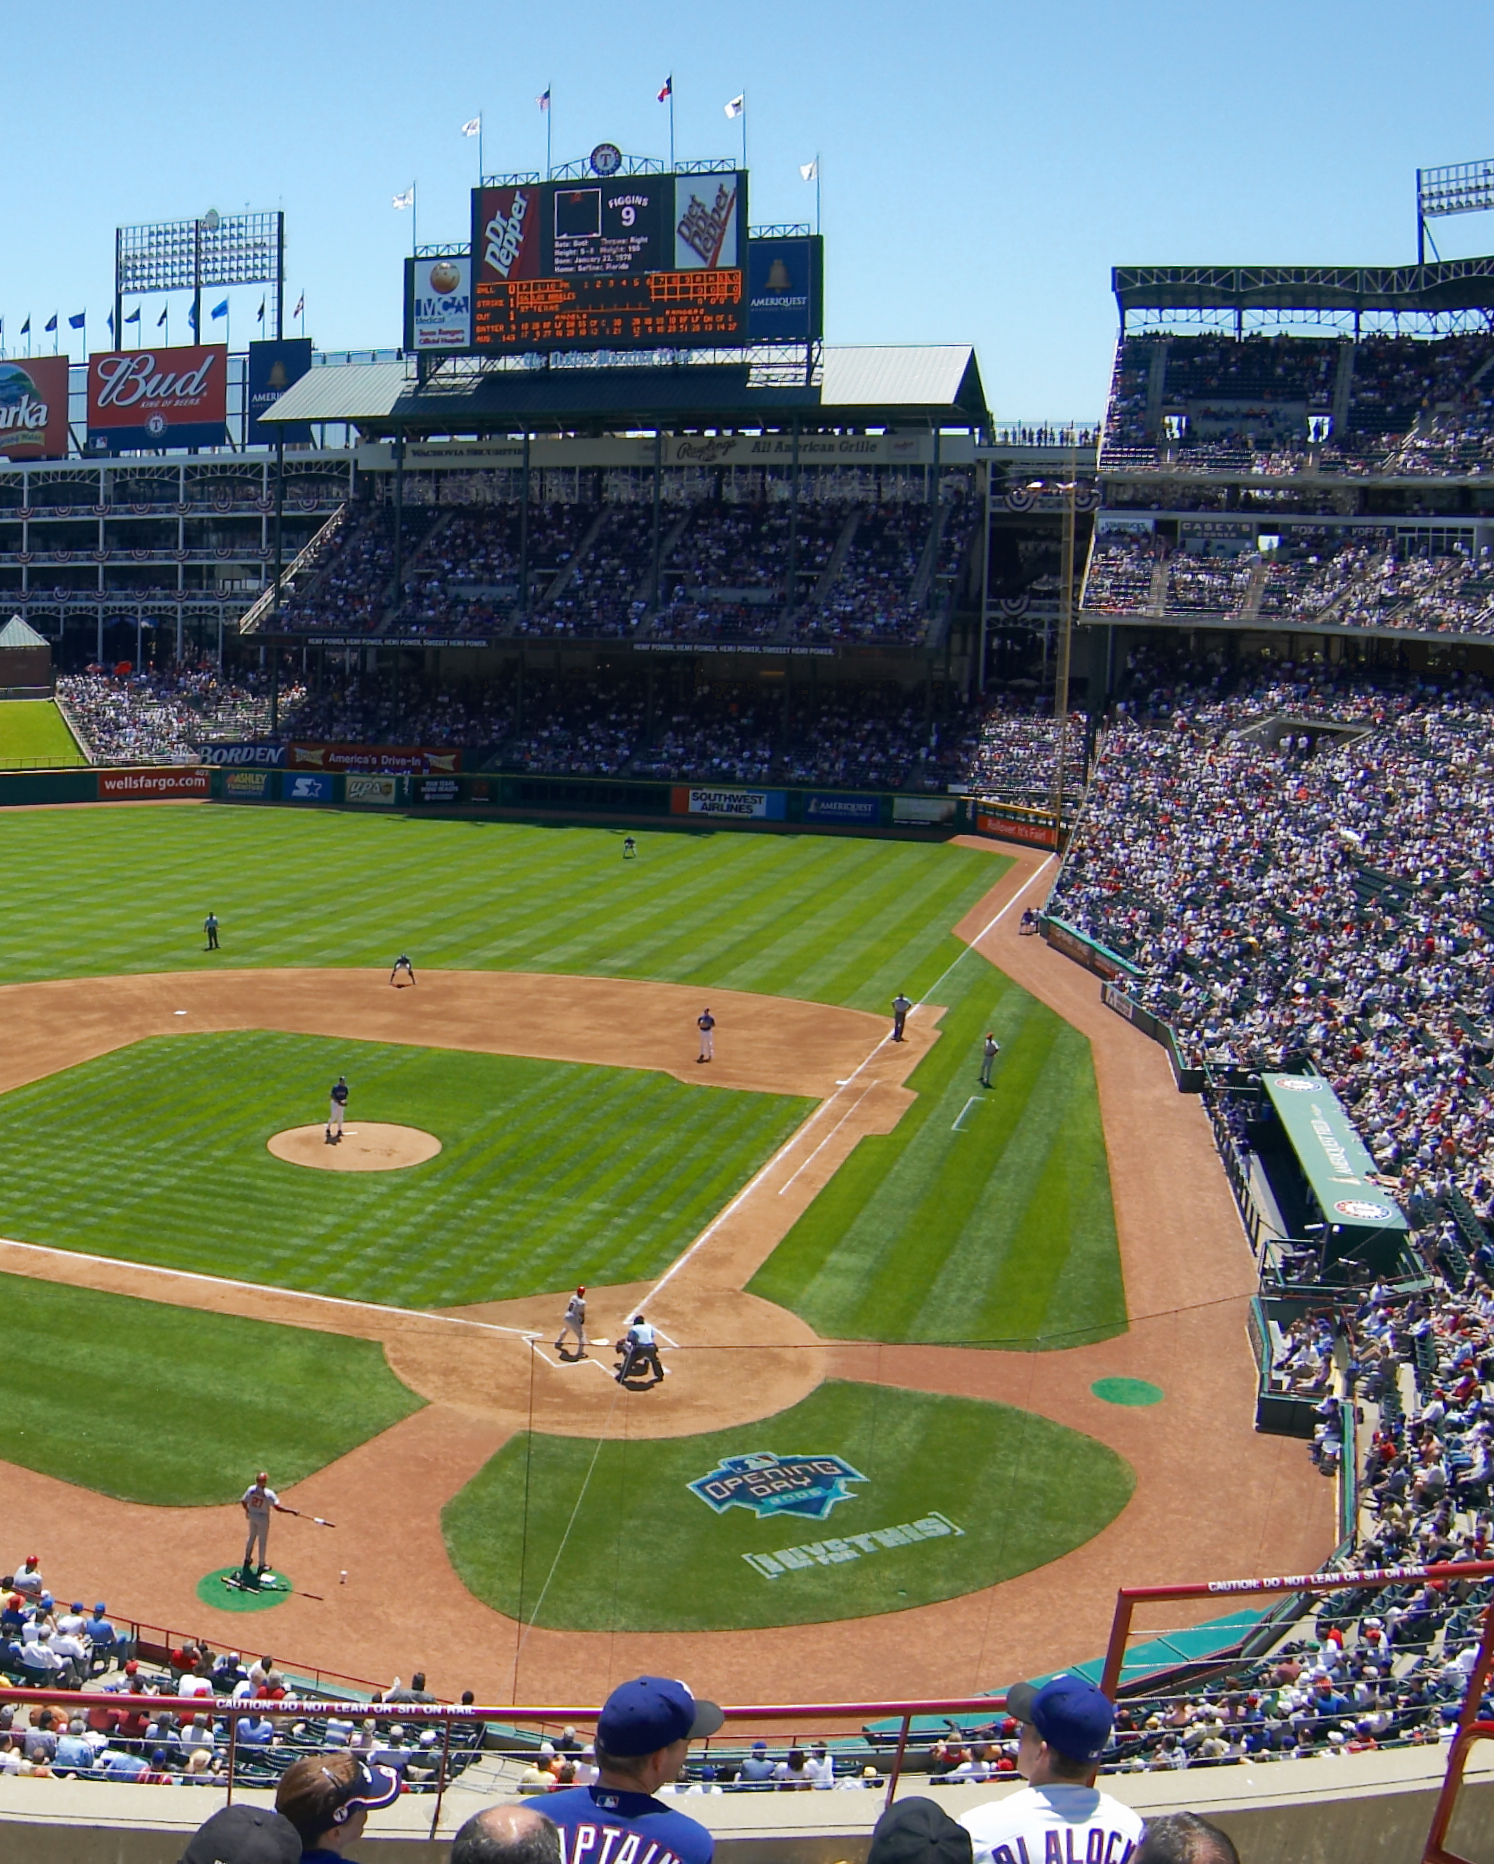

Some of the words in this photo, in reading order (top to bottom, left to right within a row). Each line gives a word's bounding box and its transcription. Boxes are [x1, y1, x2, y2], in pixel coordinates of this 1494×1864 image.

[608, 195, 649, 209] FIGGINS
[621, 206, 636, 227] 9
[485, 210, 508, 246] Dr
[689, 183, 729, 265] Pepper
[484, 190, 528, 278] Pepper
[574, 255, 601, 265] January
[476, 300, 505, 308] STRIKE
[750, 296, 808, 307] AMERIQUEST
[416, 316, 445, 325] Medical
[476, 313, 491, 321] OUT
[438, 328, 465, 338] Rangers
[476, 324, 504, 333] BATTER
[441, 336, 465, 345] Hospital
[97, 354, 215, 407] Bud
[750, 441, 772, 453] All
[1182, 522, 1251, 532] CASEY'S
[1291, 525, 1312, 536] FOX
[1318, 526, 1327, 536] 4
[1375, 527, 1387, 537] 27
[200, 745, 285, 765] BORDEN
[329, 753, 377, 766] America's
[380, 754, 422, 766] Drive-In
[105, 769, 206, 791] wellsfargo.com
[234, 774, 267, 784] ASHLEY
[349, 781, 381, 798] ups
[692, 792, 764, 804] SOUTHWEST
[700, 802, 754, 814] AIRLINES
[819, 802, 873, 812] AMERIQUEST
[1018, 824, 1030, 837] It's
[705, 1461, 844, 1501] OPENING
[749, 1477, 813, 1497] DAY
[769, 1487, 823, 1505] 2005
[1208, 1579, 1259, 1592] CAUTION:
[1262, 1577, 1281, 1589] DO
[1283, 1575, 1306, 1586] NOT
[1309, 1572, 1340, 1585] LEAN
[1343, 1570, 1360, 1582] OR
[1363, 1569, 1379, 1580] SIT
[1384, 1568, 1401, 1579] ON
[1403, 1566, 1428, 1577] RAIL
[216, 1699, 273, 1711] CAUTION:
[279, 1700, 298, 1711] DO
[303, 1700, 328, 1712] NOT
[334, 1701, 369, 1713] LEAN
[373, 1703, 394, 1714] OR
[397, 1704, 417, 1714] SIT
[423, 1704, 443, 1715] ON
[446, 1704, 476, 1715] RAIL
